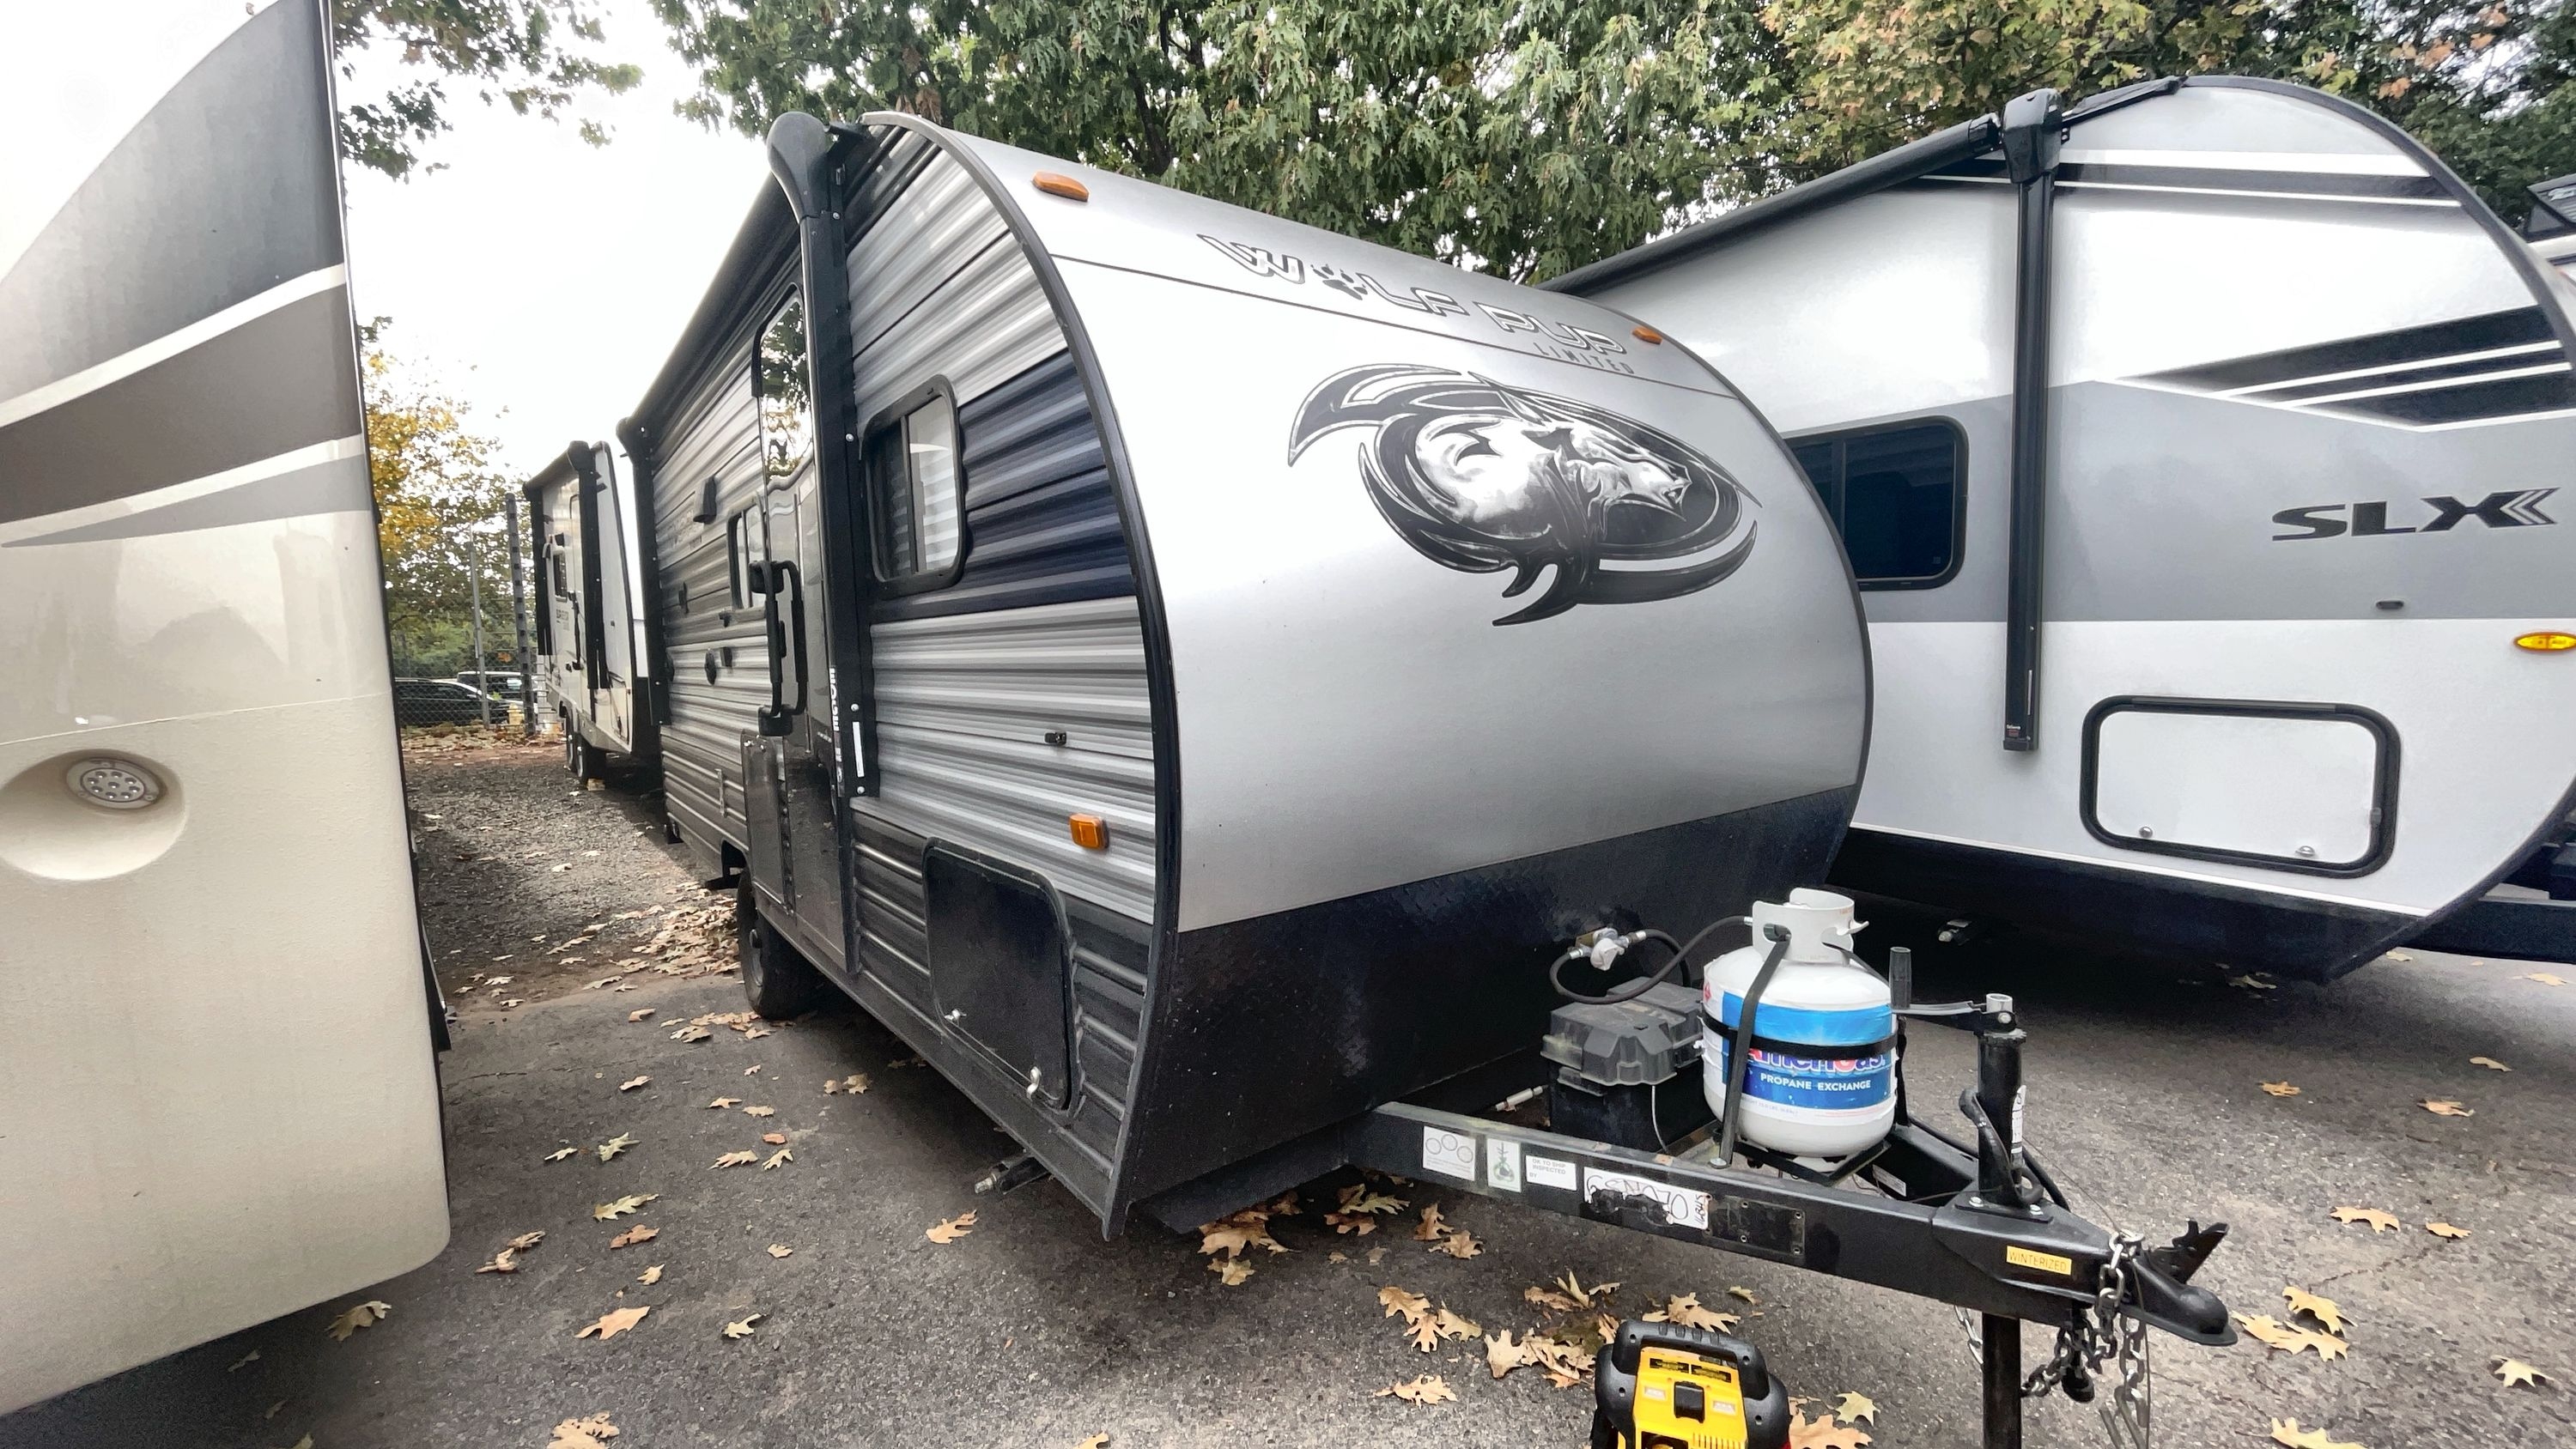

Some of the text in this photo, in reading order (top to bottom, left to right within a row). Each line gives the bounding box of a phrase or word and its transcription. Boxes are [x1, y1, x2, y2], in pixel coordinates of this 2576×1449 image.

[1196, 233, 1627, 355] WLF PUP
[1533, 342, 1635, 374] LIMITED
[2271, 487, 2561, 542] SLX
[1760, 1072, 1872, 1092] PROPANE EXCHANGE
[1533, 1164, 1566, 1174] INSPECTED
[2009, 1251, 2067, 1272] WINTERIZED
